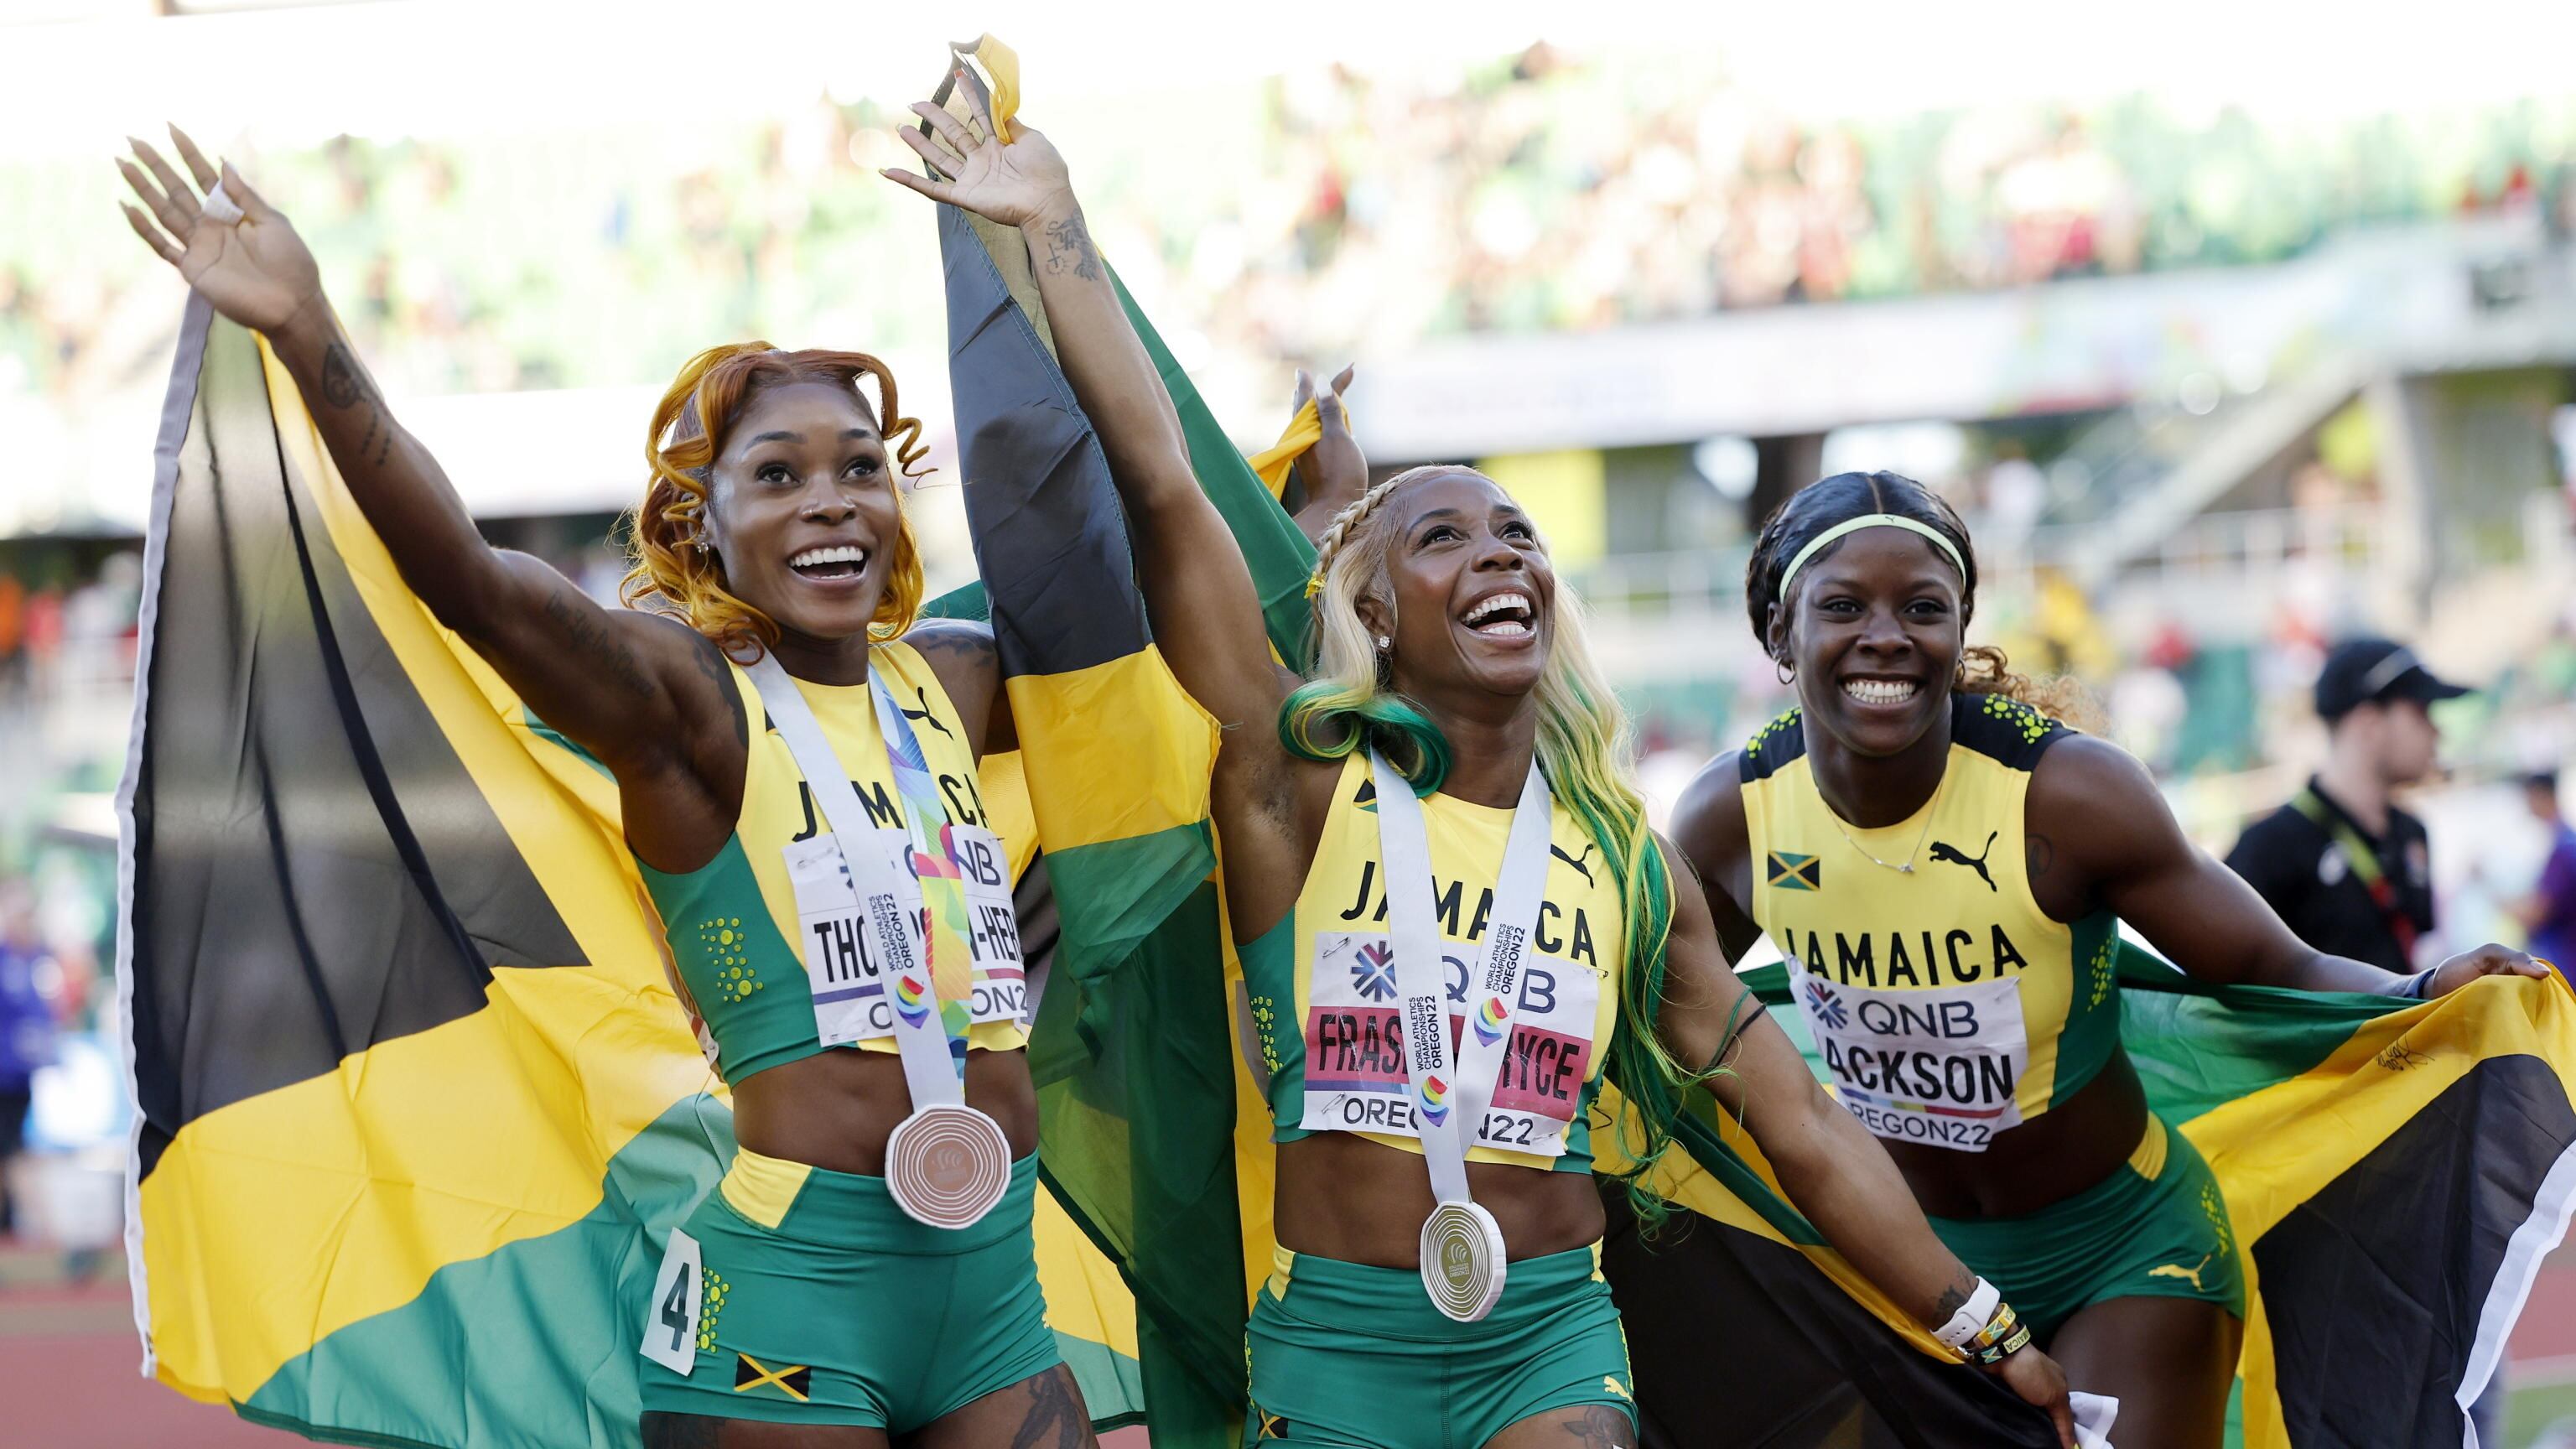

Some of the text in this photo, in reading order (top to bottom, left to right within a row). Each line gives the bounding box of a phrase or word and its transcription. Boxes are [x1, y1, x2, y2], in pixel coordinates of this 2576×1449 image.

[792, 773, 989, 843] JMCA
[869, 895, 896, 973] WORLD ATHLETICS
[875, 894, 904, 971] CHAMPIONSHIPS
[1340, 860, 1597, 969] JMACA
[1441, 955, 1556, 1014] QB
[1485, 923, 1507, 989] WORLD ATHLETICS
[1493, 925, 1514, 992] CHAMPIONSHIPS
[1409, 996, 1424, 1072] WORLD ATHLETICS
[1416, 996, 1431, 1070] CHAMPIONSHIPS
[1858, 1000, 1979, 1038] QNB
[1826, 1036, 2014, 1104] ACKSON
[1849, 1102, 1991, 1146] REGON22
[661, 1262, 690, 1352] 4
